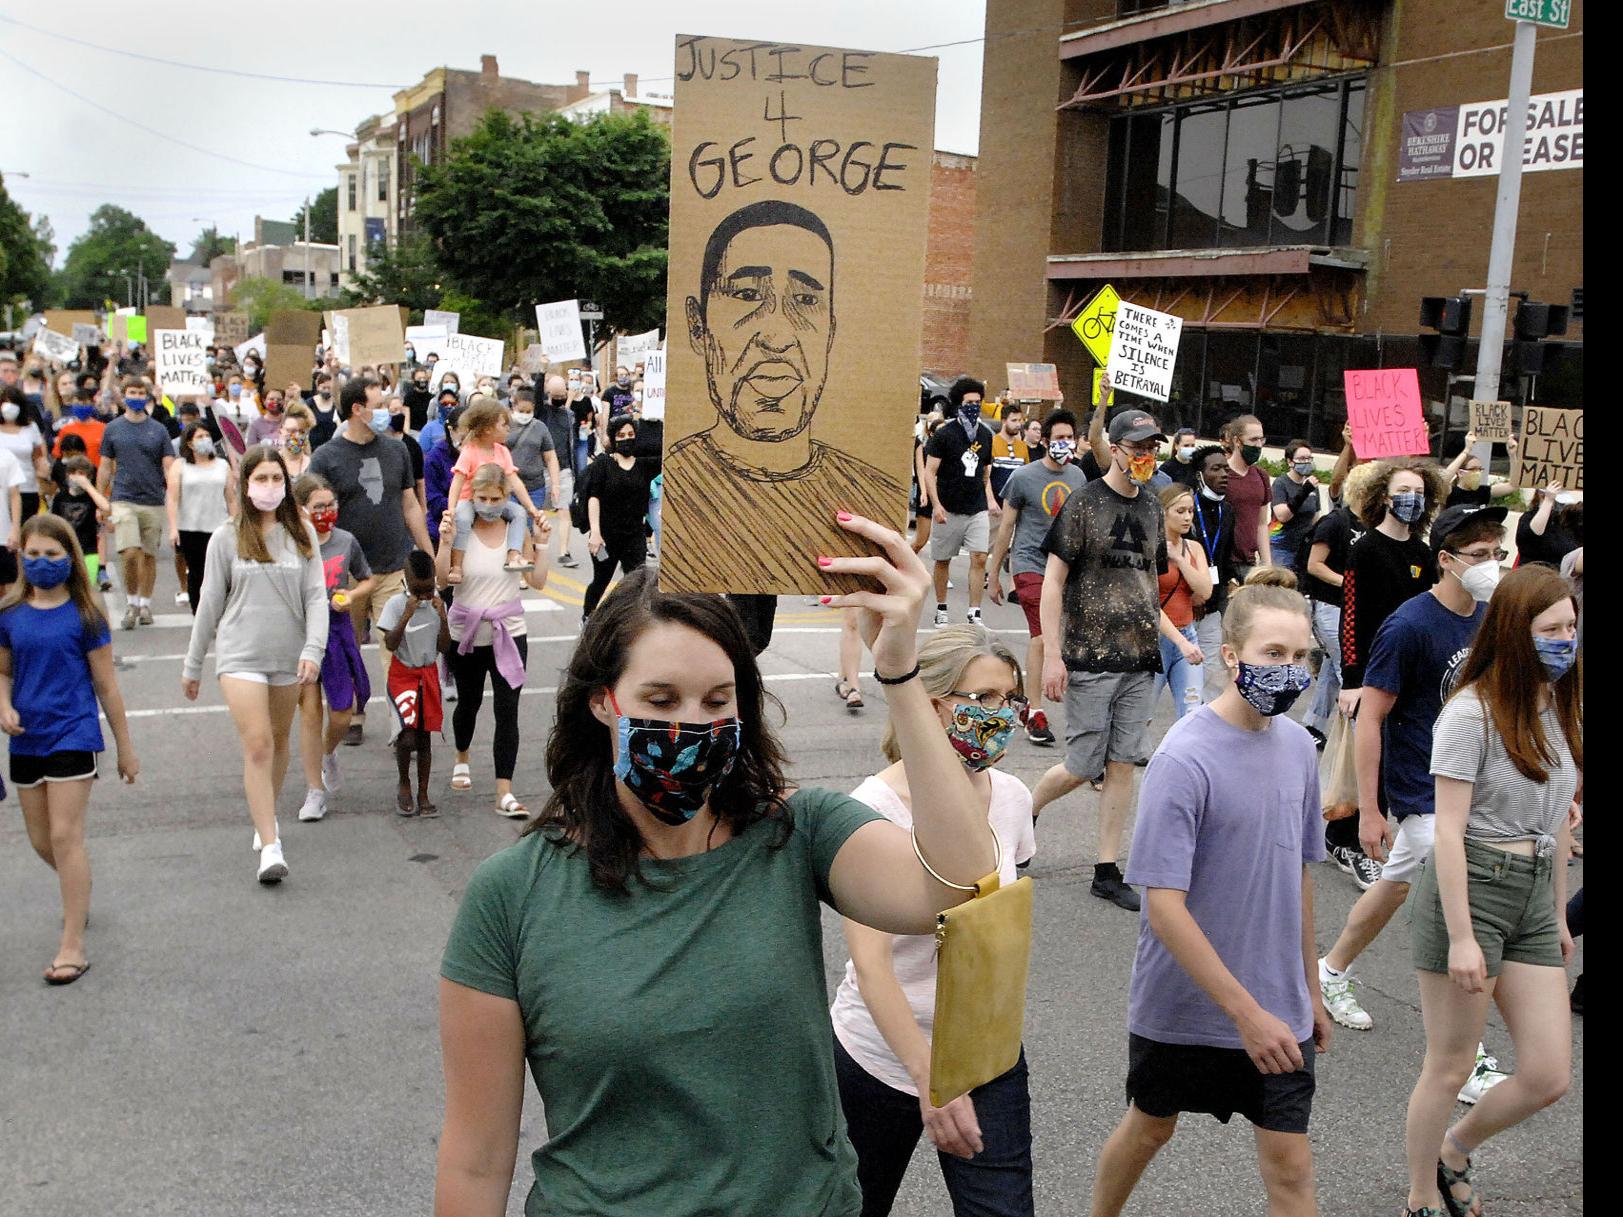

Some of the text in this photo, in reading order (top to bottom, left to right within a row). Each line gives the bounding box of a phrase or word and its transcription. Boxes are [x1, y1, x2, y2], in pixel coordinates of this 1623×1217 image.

[1509, 0, 1567, 23] East St
[677, 36, 876, 88] JUSTICE
[763, 89, 803, 143] 4
[1459, 132, 1583, 170] OR EASE
[688, 136, 918, 199] GEORGE
[1124, 307, 1158, 328] THERE
[162, 333, 202, 349] BLACK
[1119, 320, 1162, 343] COMES A
[1119, 331, 1174, 356] TIME WHEN
[162, 353, 203, 366] LIVES
[1118, 344, 1169, 370] SILENCE
[160, 370, 206, 385] MATTER
[1130, 363, 1145, 375] IS
[1114, 370, 1167, 397] BETRAYAL
[1353, 371, 1408, 400] BLACK
[1353, 403, 1406, 428] LIVES
[1475, 403, 1507, 418] BLACK
[1478, 417, 1506, 426] LIVES
[1475, 427, 1508, 438] MATTER
